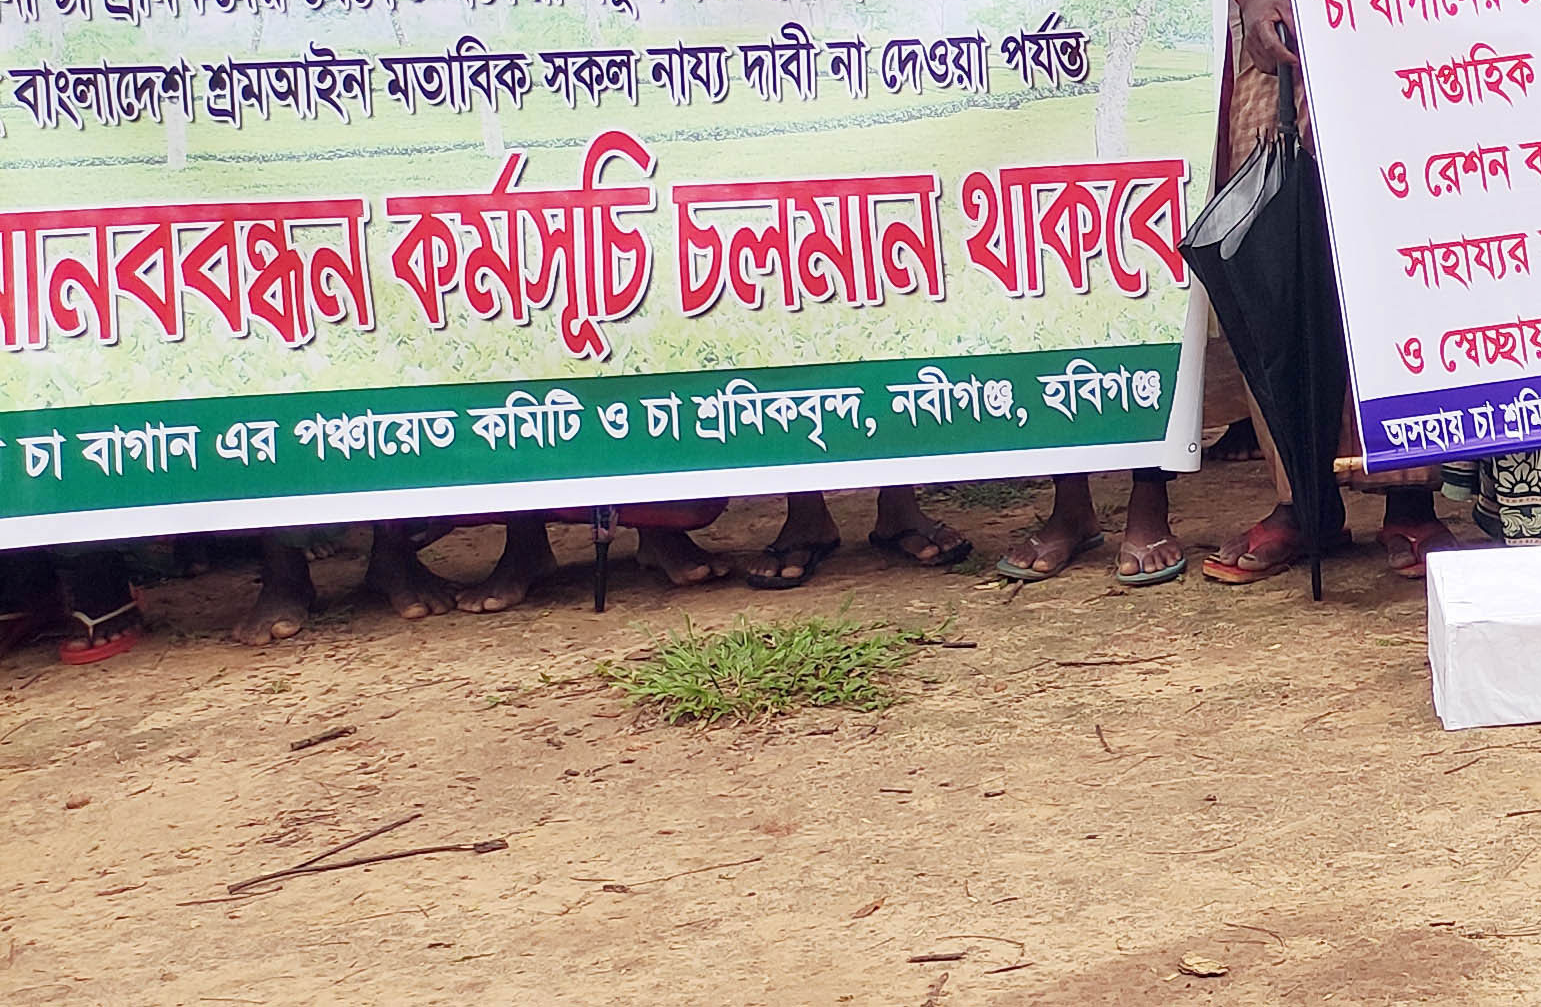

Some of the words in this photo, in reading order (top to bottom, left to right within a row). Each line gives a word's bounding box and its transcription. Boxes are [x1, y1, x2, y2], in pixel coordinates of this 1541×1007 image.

[8, 59, 194, 128] বাংলাদেশ
[201, 41, 368, 125] শ্রমআইন
[539, 50, 635, 106] সকল
[738, 22, 822, 98] দাবী
[826, 38, 864, 93] না
[882, 33, 985, 92] দেওয়া
[1001, 12, 1084, 85] পর্যন্ত
[1395, 43, 1534, 108] সাপ্তাহিক
[1382, 162, 1408, 198] ও
[1425, 145, 1510, 197] রেশন
[386, 131, 650, 356] কর্মসূচি
[672, 175, 939, 312] চলমান
[962, 160, 1184, 292] থাকবে
[1396, 338, 1424, 374] ও
[16, 429, 66, 480] চা
[76, 422, 200, 475] বাগান
[216, 421, 279, 465] এর
[294, 409, 457, 459] পঞ্চায়েত
[467, 389, 584, 449] কমিটি
[597, 403, 628, 438] ও
[640, 392, 682, 440] চা
[691, 379, 876, 450] শ্রমিকবৃন্দ,
[887, 367, 1027, 426] নবীগঞ্জ,
[1037, 359, 1161, 420] হবিগঞ্জ
[1381, 405, 1465, 452] অসহায়
[1468, 401, 1496, 439] চা
